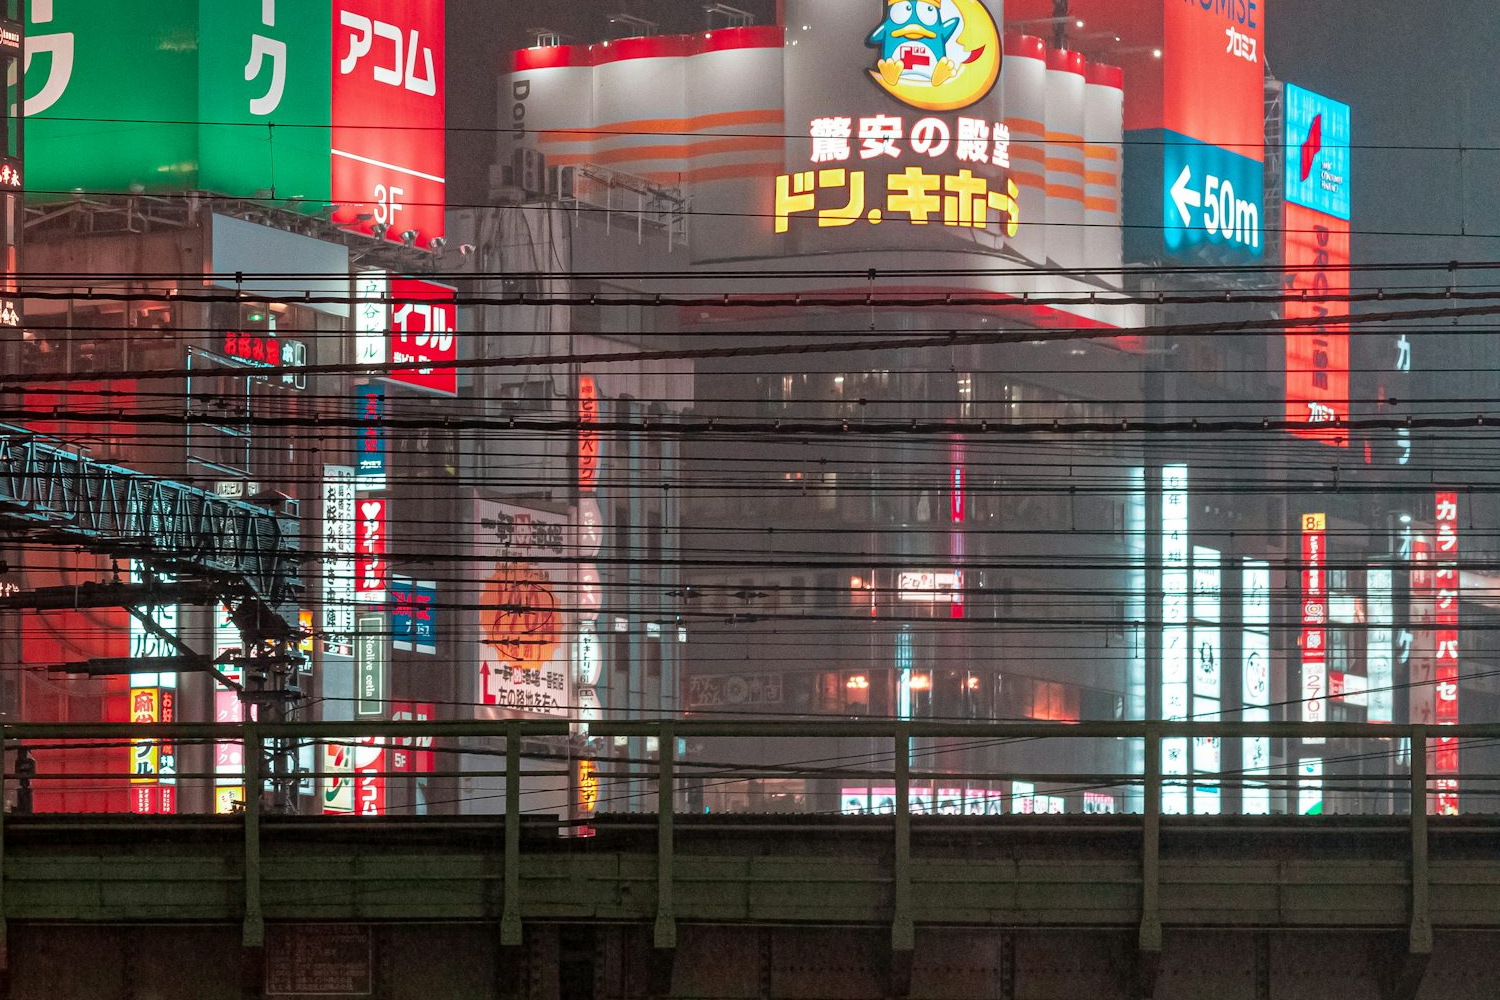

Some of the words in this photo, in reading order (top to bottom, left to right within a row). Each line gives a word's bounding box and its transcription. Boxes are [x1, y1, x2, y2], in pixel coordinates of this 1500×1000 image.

[340, 10, 437, 97] アコム
[1226, 26, 1257, 63] プロミス
[513, 80, 530, 140] Don
[810, 114, 1010, 169] 驚安の殿堂
[373, 183, 404, 226] 3F
[1203, 174, 1258, 248] 50m
[392, 296, 454, 351] イフル
[394, 753, 407, 768] 5F
